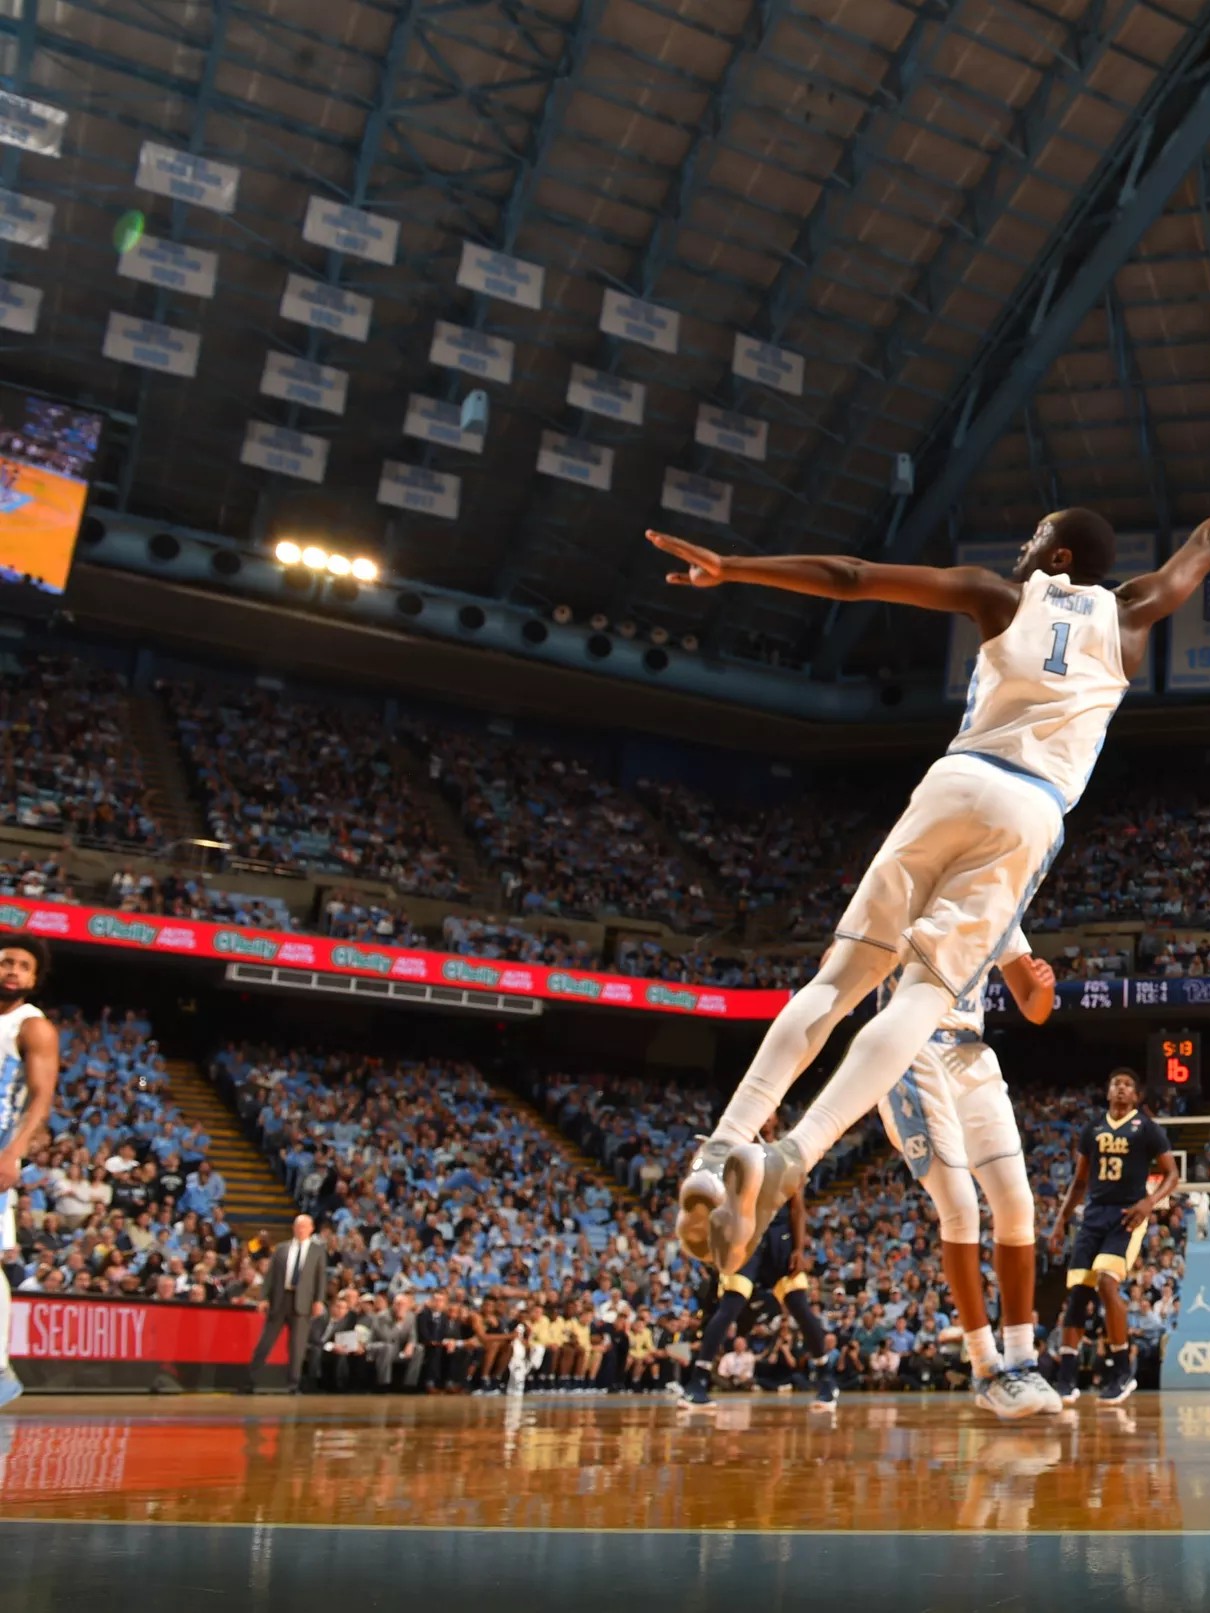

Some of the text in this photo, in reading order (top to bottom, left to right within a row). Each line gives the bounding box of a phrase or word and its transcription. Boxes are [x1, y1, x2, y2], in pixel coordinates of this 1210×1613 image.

[1043, 622, 1070, 676] 1
[1081, 995, 1111, 1008] 47%
[1095, 1132, 1129, 1154] Pitt
[1098, 1156, 1123, 1181] 13
[33, 1304, 146, 1358] SECURITY
